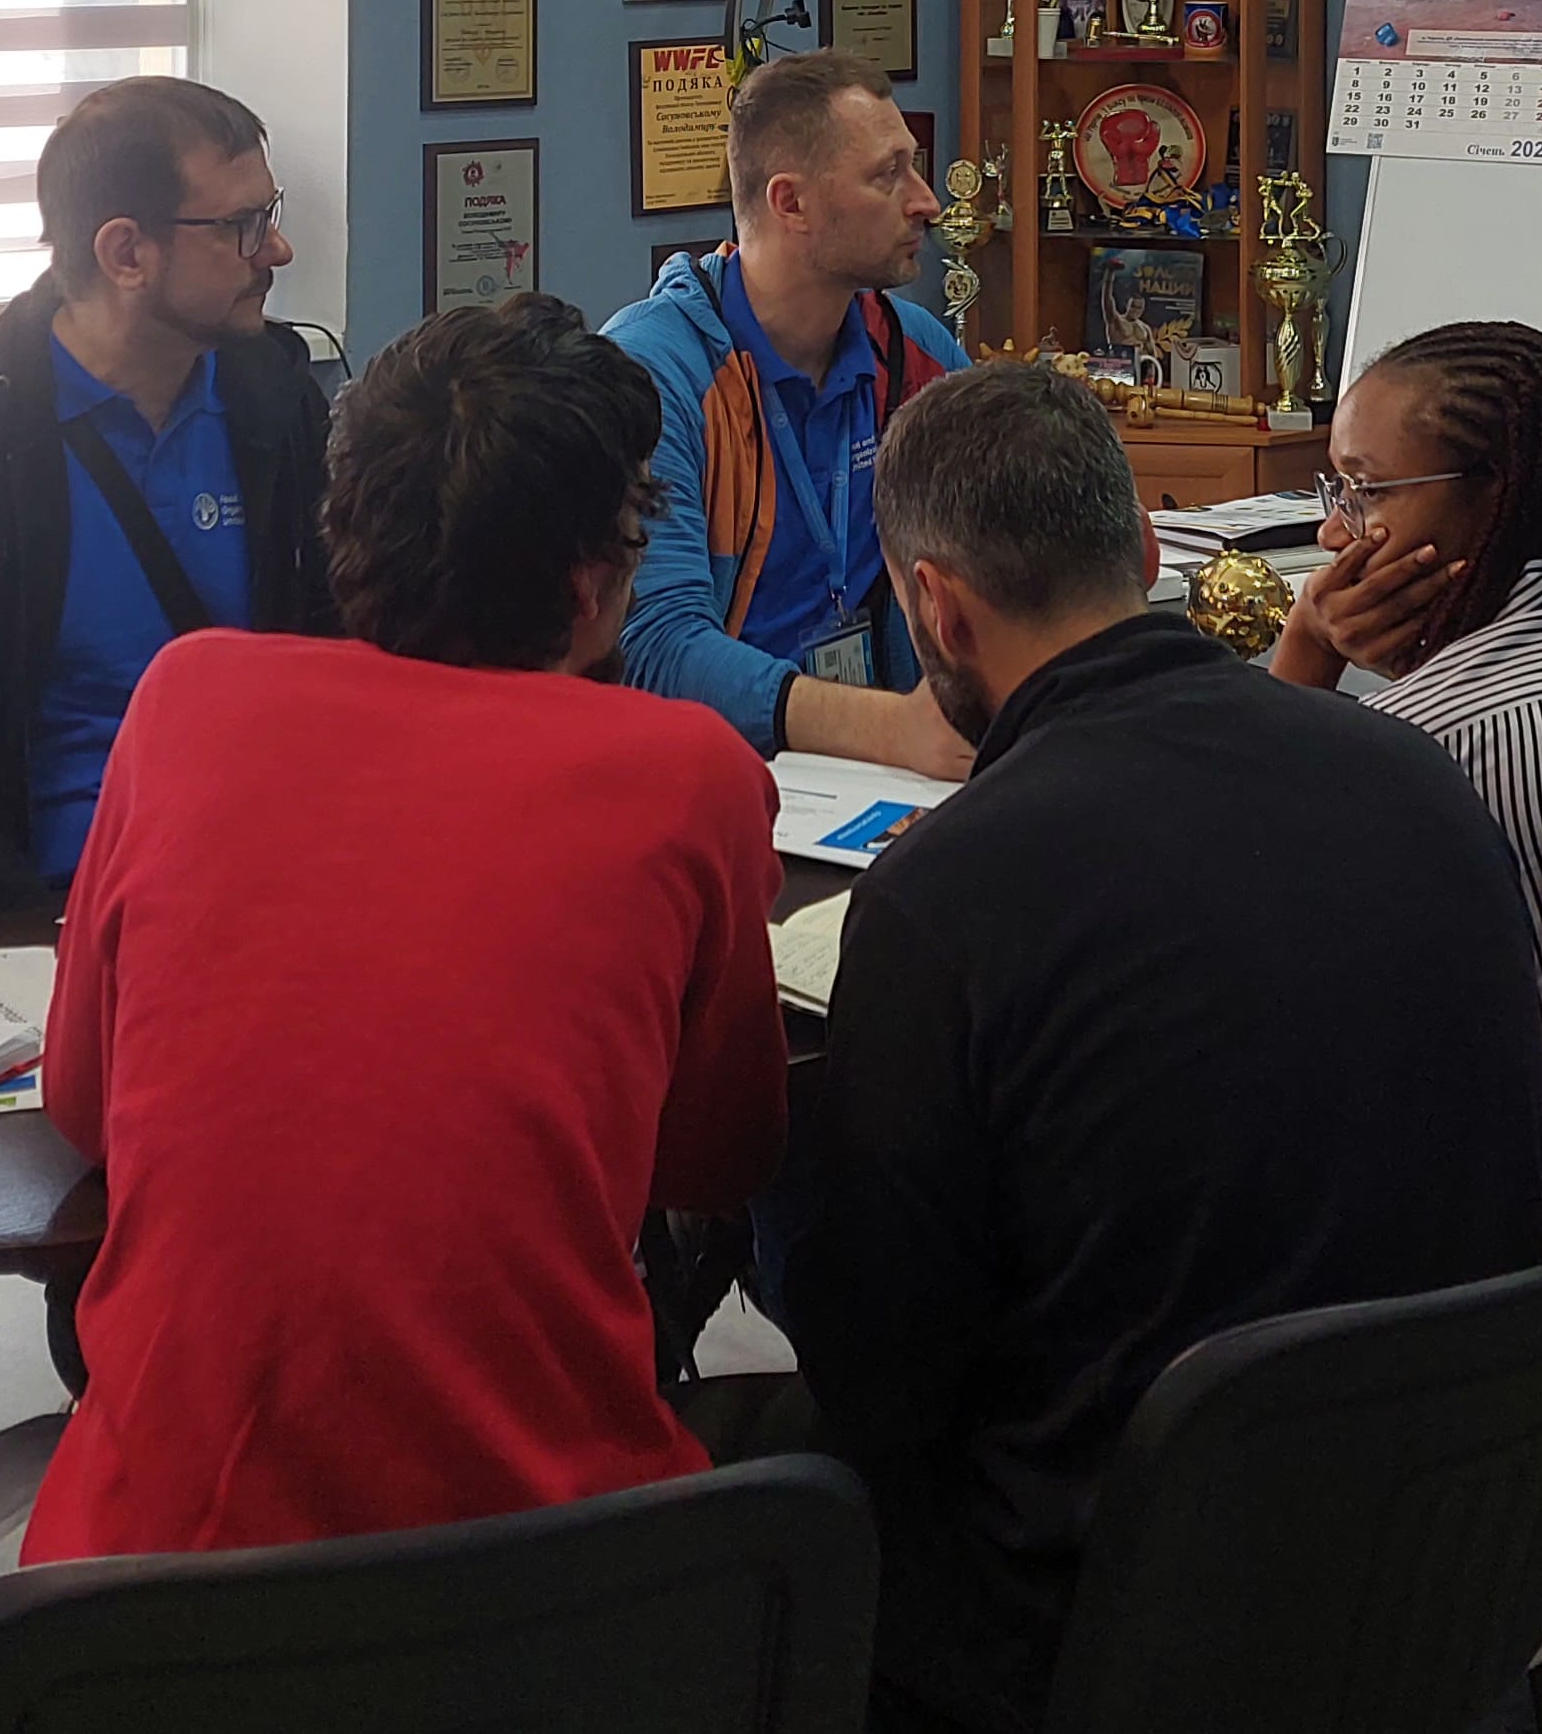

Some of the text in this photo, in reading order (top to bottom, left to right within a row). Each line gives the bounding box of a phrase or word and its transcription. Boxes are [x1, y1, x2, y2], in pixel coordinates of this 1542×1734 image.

[653, 46, 723, 72] WWFC
[1354, 66, 1360, 76] 1
[1384, 67, 1393, 77] 2
[1415, 69, 1424, 78] 3
[1447, 70, 1456, 79] 4
[1479, 71, 1488, 80] 5
[653, 75, 723, 93] ПОДЯКА
[1351, 79, 1360, 88] 8
[1382, 80, 1391, 89] 9
[1411, 81, 1426, 91] 10
[1442, 82, 1457, 92] 11
[1474, 83, 1490, 93] 12
[1347, 91, 1362, 101] 15
[1377, 92, 1392, 102] 16
[1409, 94, 1425, 104] 17
[1441, 95, 1456, 105] 18
[1473, 96, 1488, 106] 19
[1344, 104, 1360, 113] 22
[1375, 105, 1391, 115] 23
[1406, 106, 1422, 116] 24
[1438, 108, 1454, 118] 25
[1470, 109, 1487, 119] 26
[1342, 116, 1420, 130] 29 30 31
[464, 195, 507, 208] ПОДЯКА
